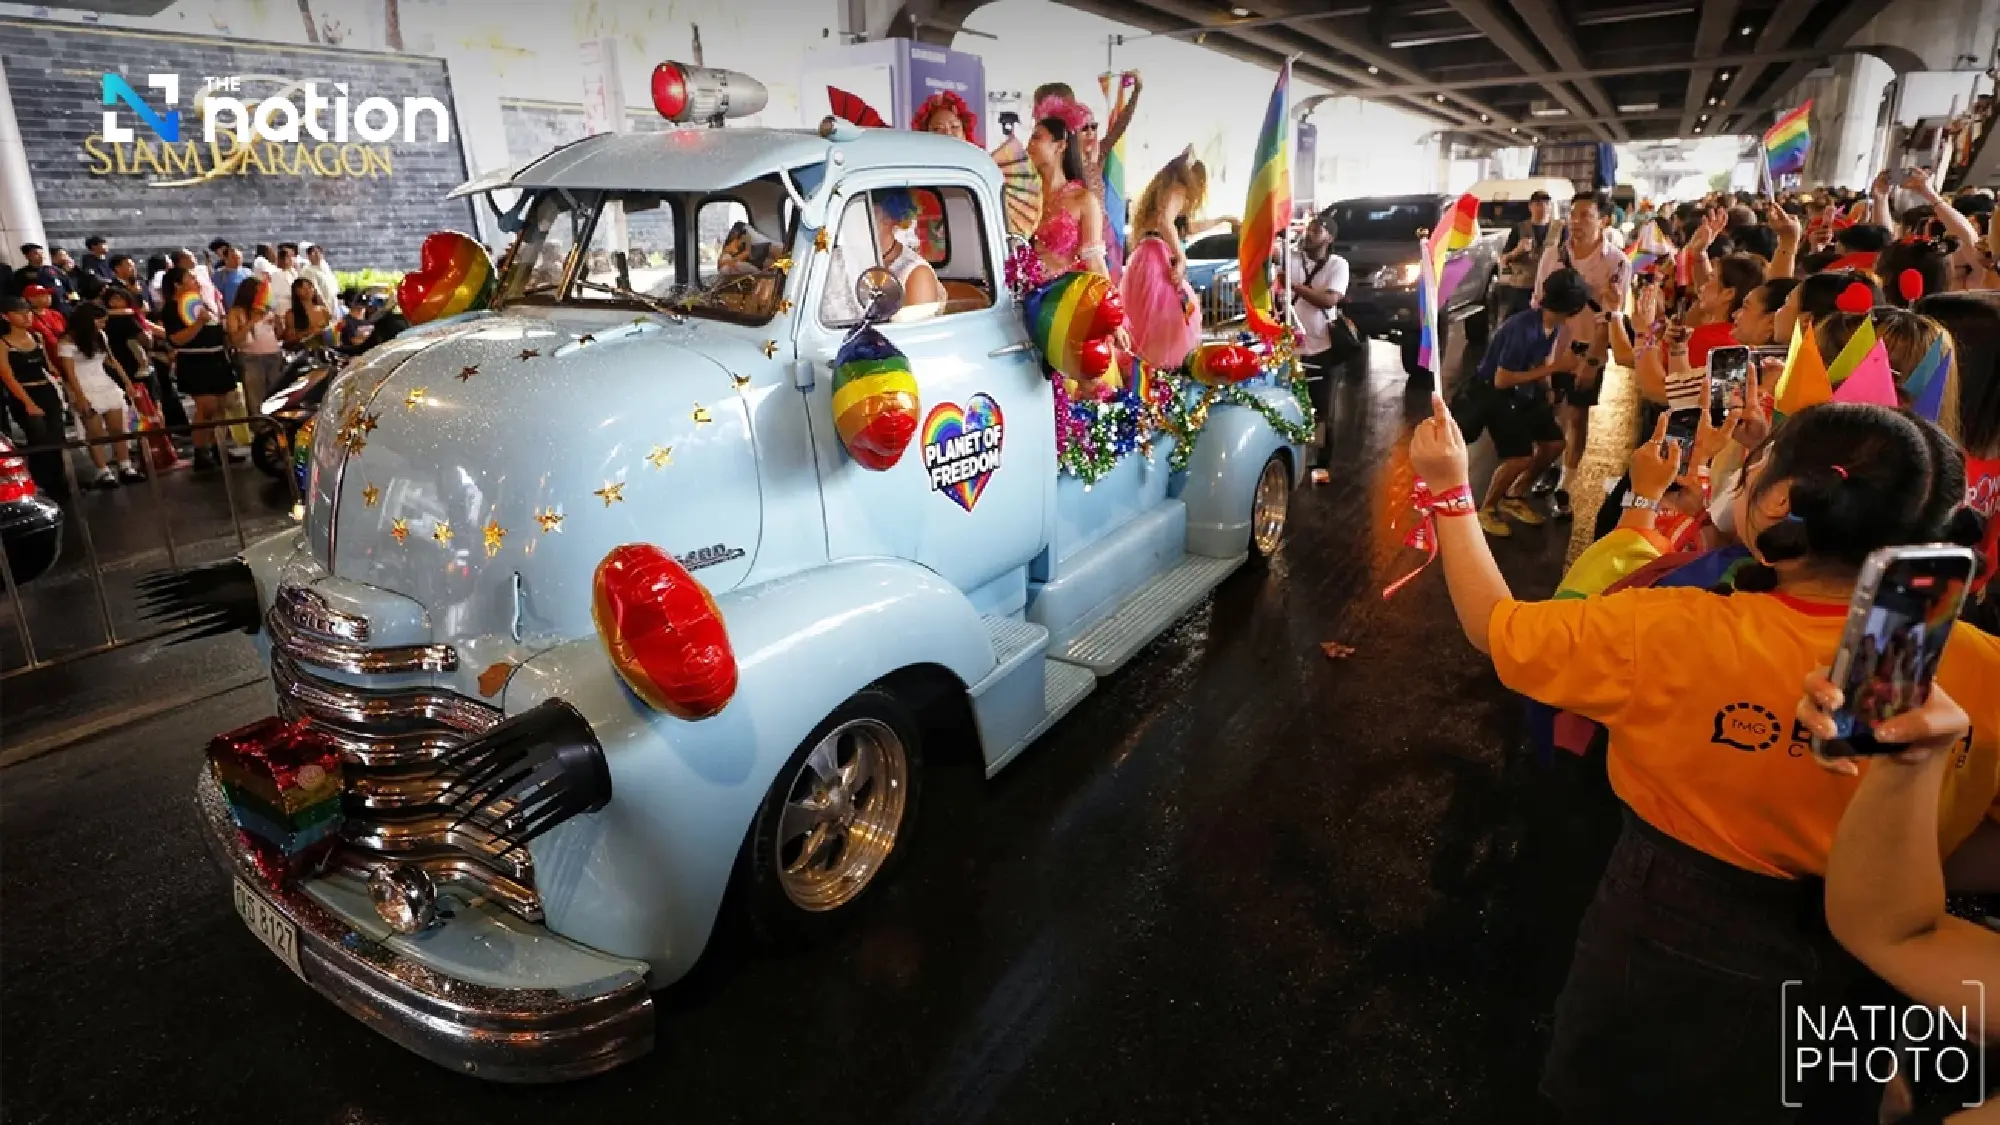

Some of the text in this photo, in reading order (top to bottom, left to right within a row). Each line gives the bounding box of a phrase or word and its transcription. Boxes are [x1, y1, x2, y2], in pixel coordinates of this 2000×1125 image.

[84, 127, 394, 179] SIAM PARAGON
[925, 423, 1003, 469] PLANET OF
[930, 447, 1003, 492] FREEDOM
[1731, 718, 1766, 735] TMG
[260, 904, 293, 957] 8127
